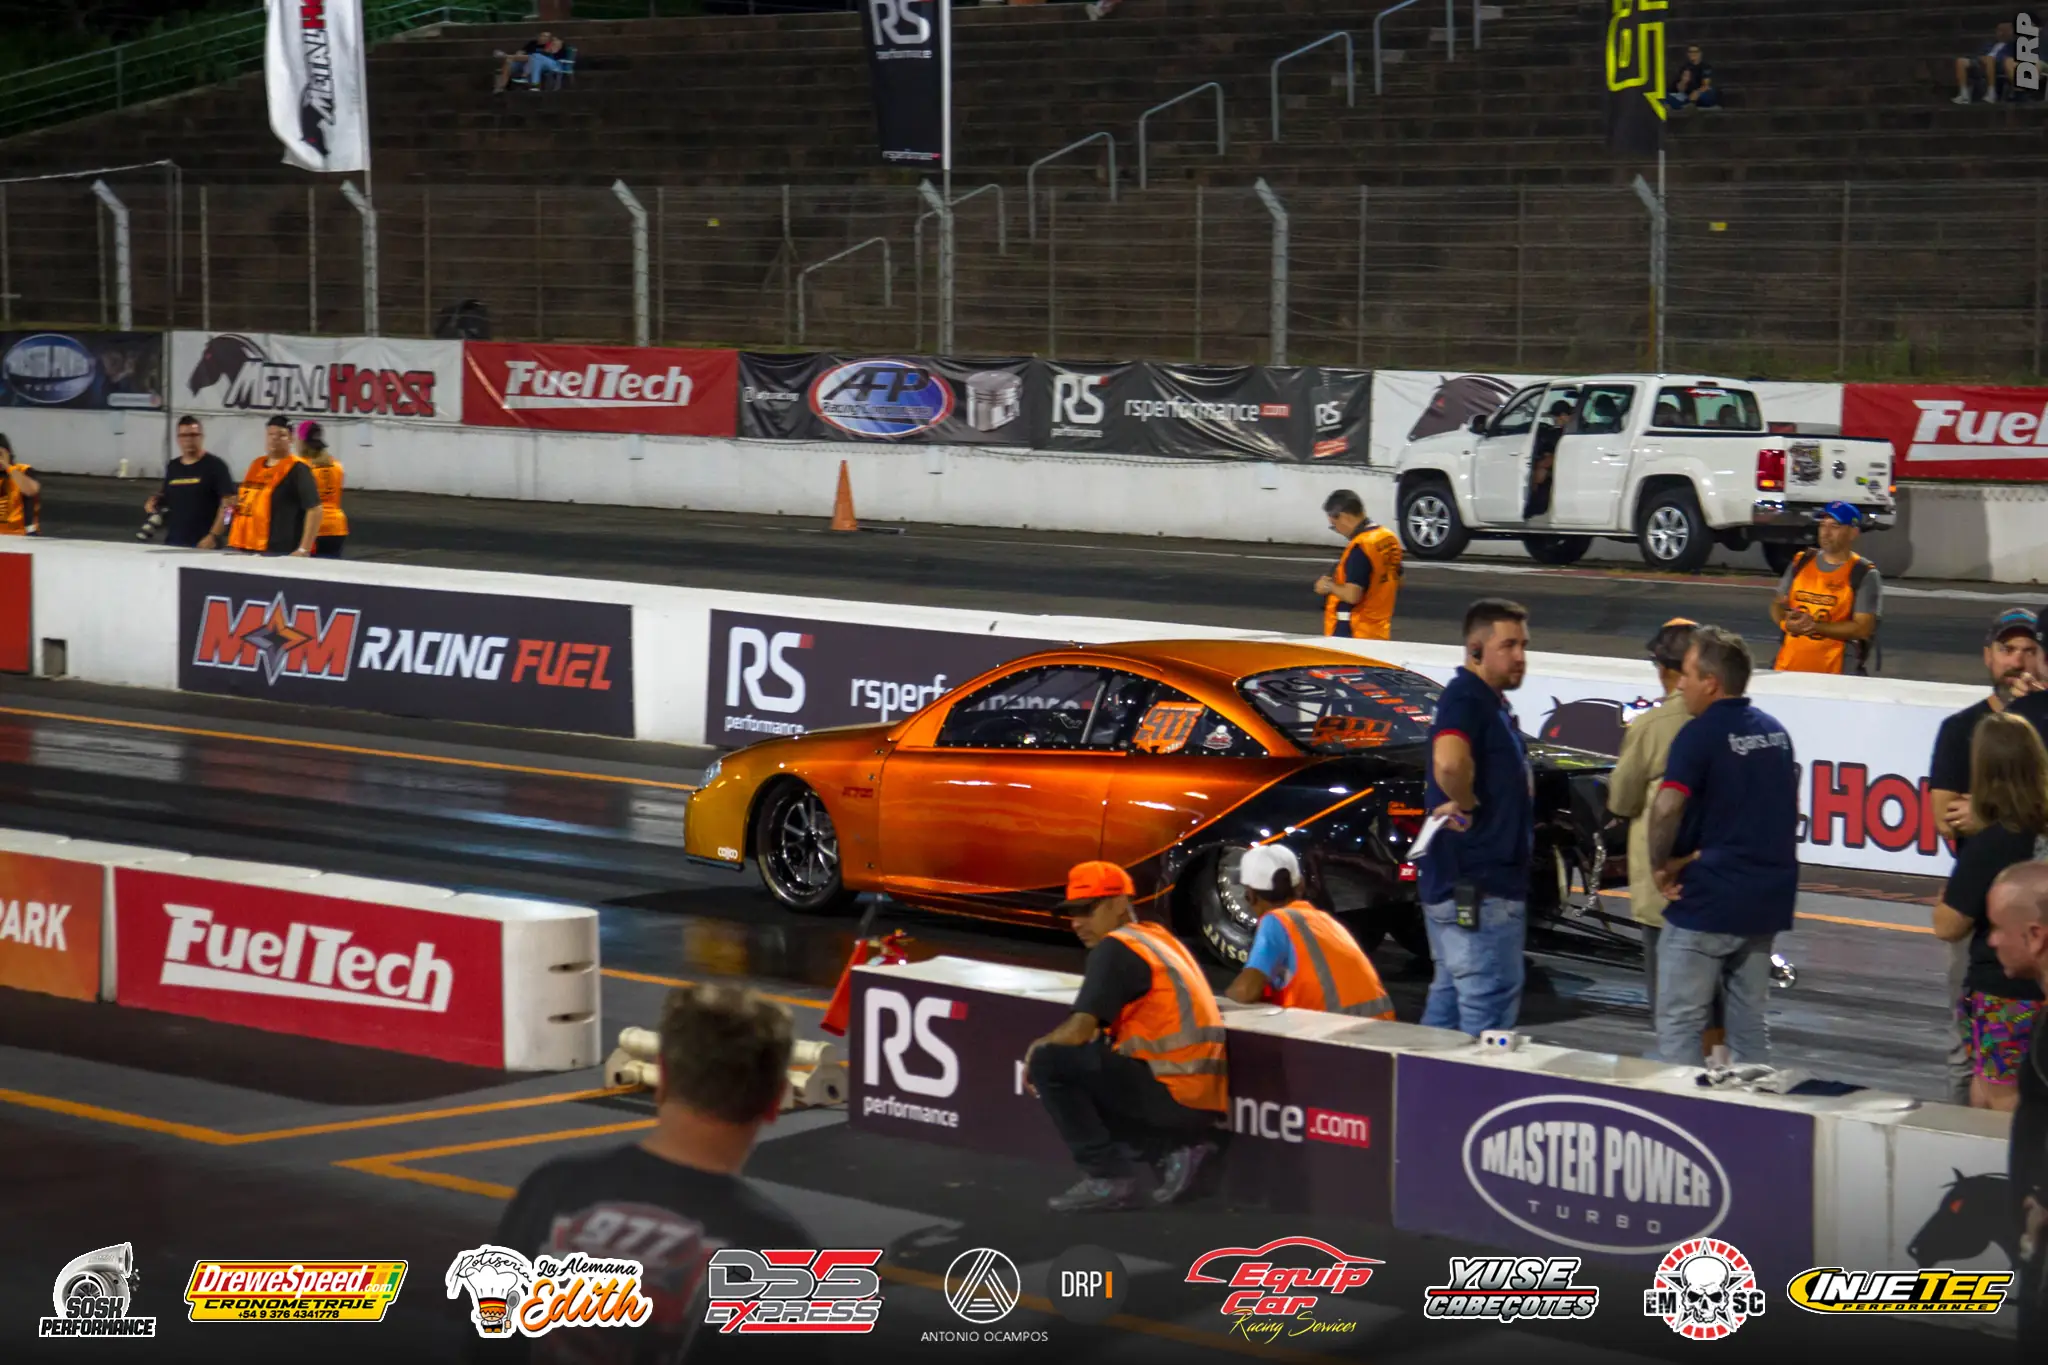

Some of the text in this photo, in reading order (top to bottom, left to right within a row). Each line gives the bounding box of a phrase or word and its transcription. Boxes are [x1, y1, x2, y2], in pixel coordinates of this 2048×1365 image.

[868, 0, 931, 45] RS
[504, 360, 693, 406] FuelTech
[1053, 374, 1105, 424] RS
[359, 627, 509, 681] RACING
[511, 638, 612, 691] FUEL
[726, 626, 806, 713] RS
[163, 903, 454, 1012] FuelTech
[864, 988, 959, 1098] RS
[863, 1095, 959, 1128] performance
[1481, 1121, 1711, 1208] MASTER POWER
[1529, 1200, 1662, 1235] TURBO
